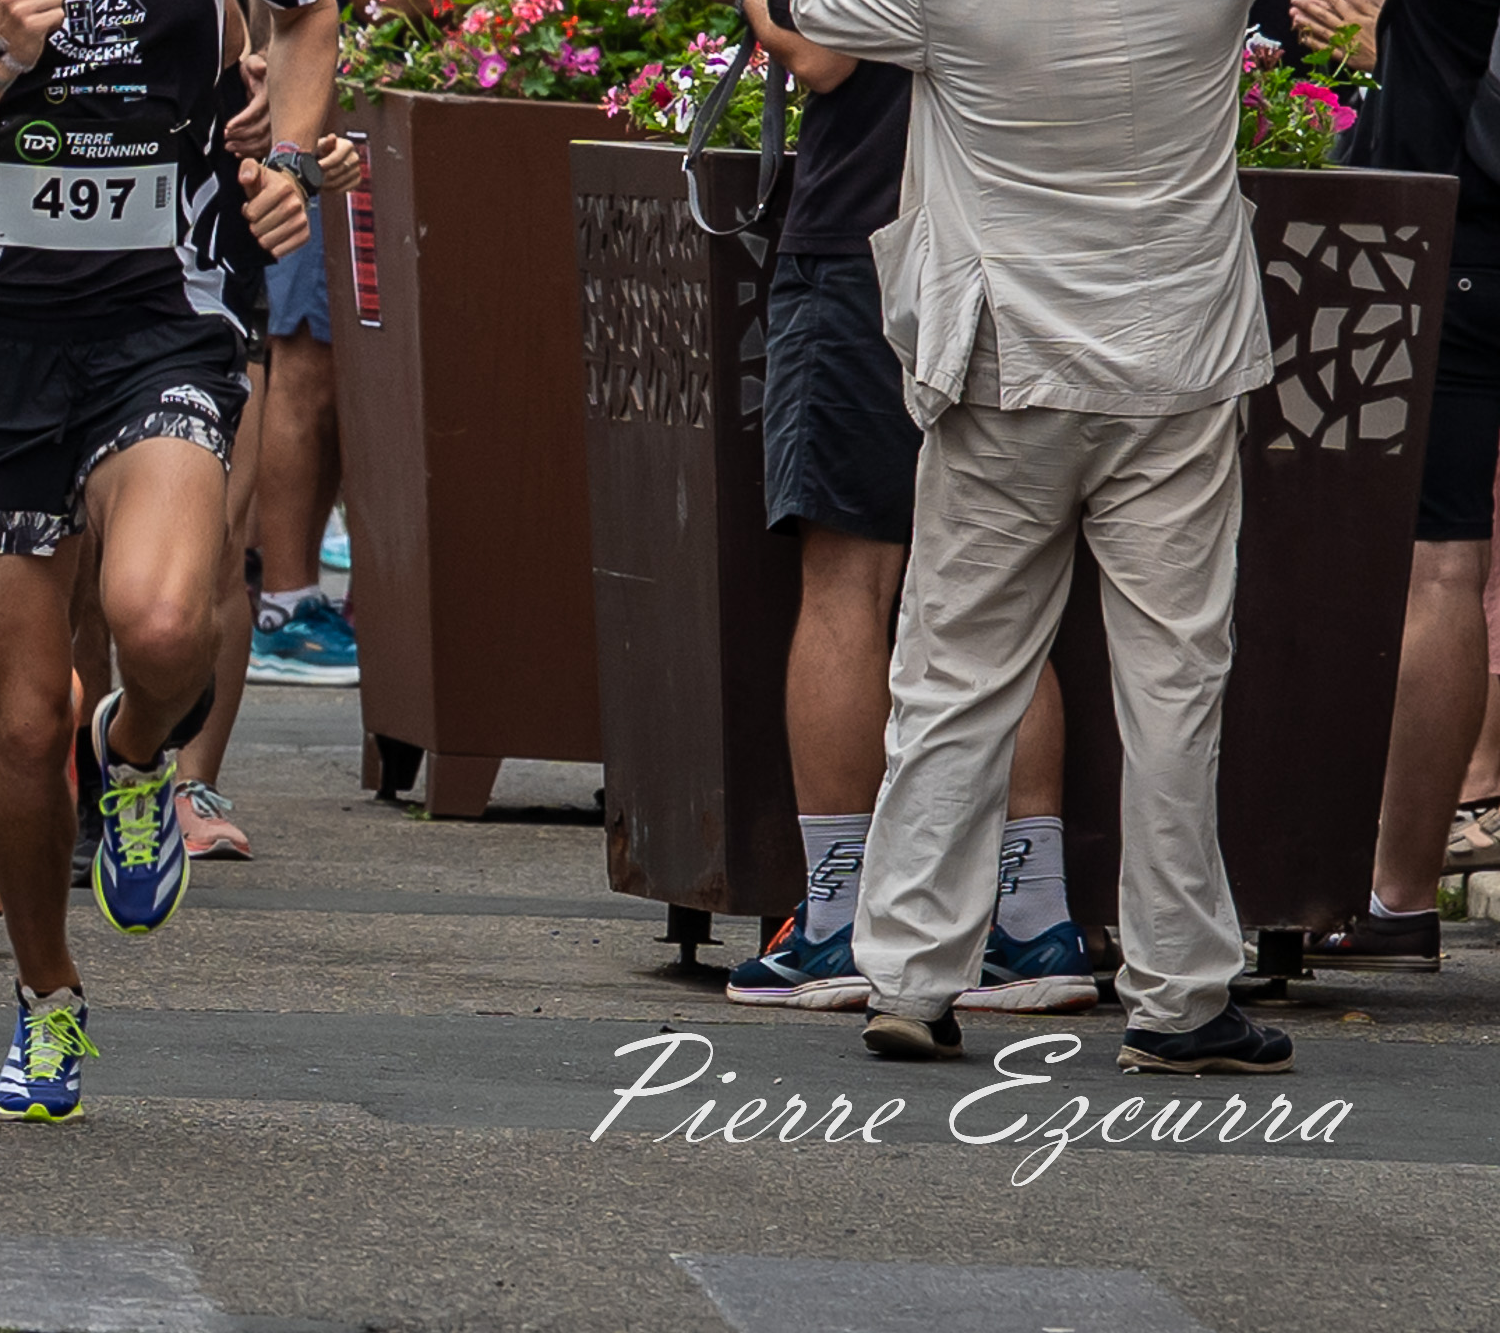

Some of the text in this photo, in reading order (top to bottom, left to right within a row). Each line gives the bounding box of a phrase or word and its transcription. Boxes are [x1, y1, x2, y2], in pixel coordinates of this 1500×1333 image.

[96, 10, 146, 28] Ascain
[23, 134, 56, 151] TDR
[66, 133, 113, 145] TERRE
[85, 142, 158, 158] RUNNING
[32, 178, 136, 220] 497
